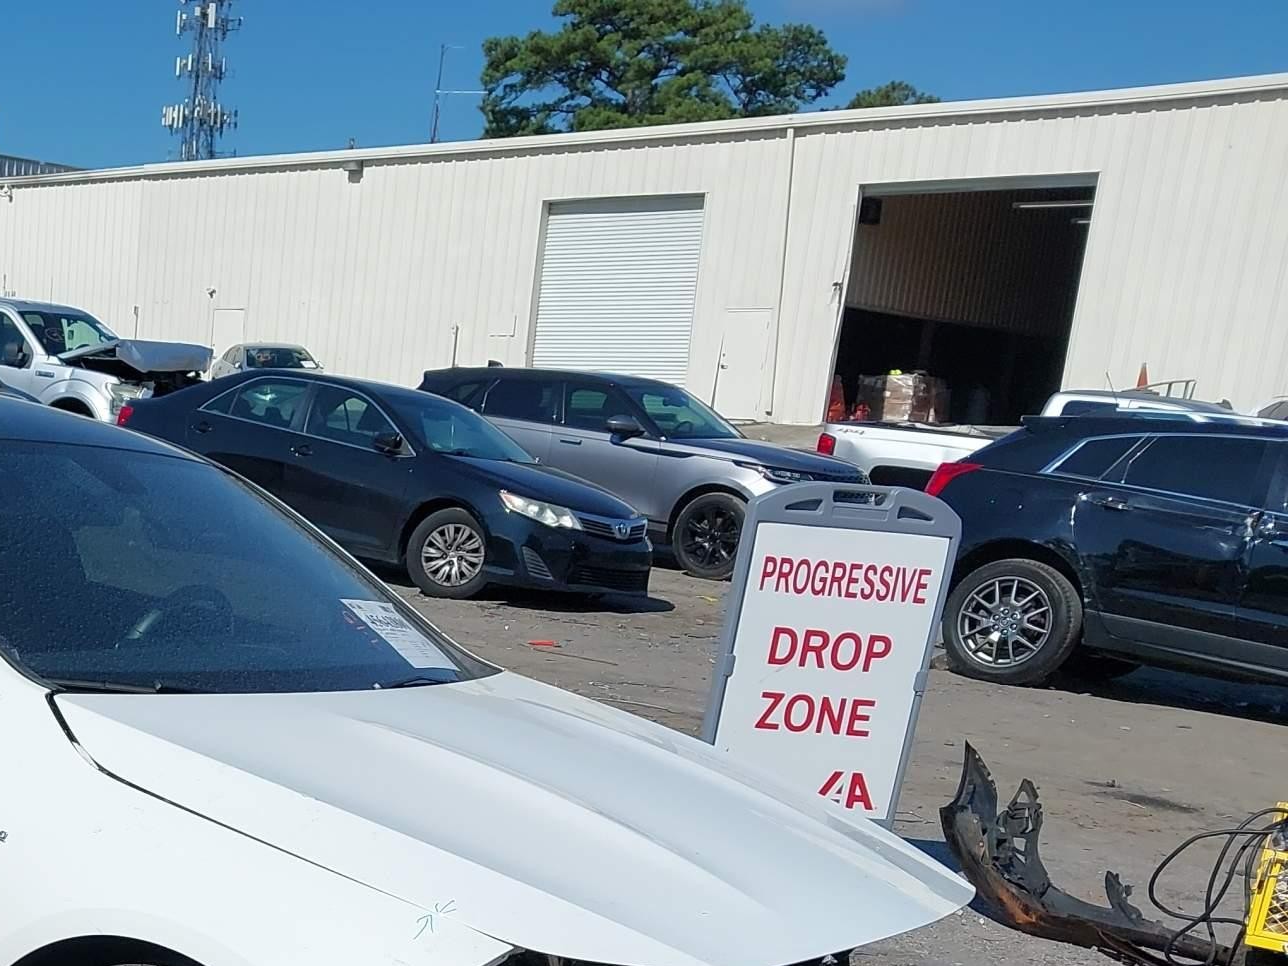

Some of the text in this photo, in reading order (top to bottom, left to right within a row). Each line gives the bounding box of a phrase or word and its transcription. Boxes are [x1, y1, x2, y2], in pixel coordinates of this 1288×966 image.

[759, 555, 932, 605] PROGRESSIVE
[767, 626, 893, 673] DROP
[754, 691, 876, 737] ZONE
